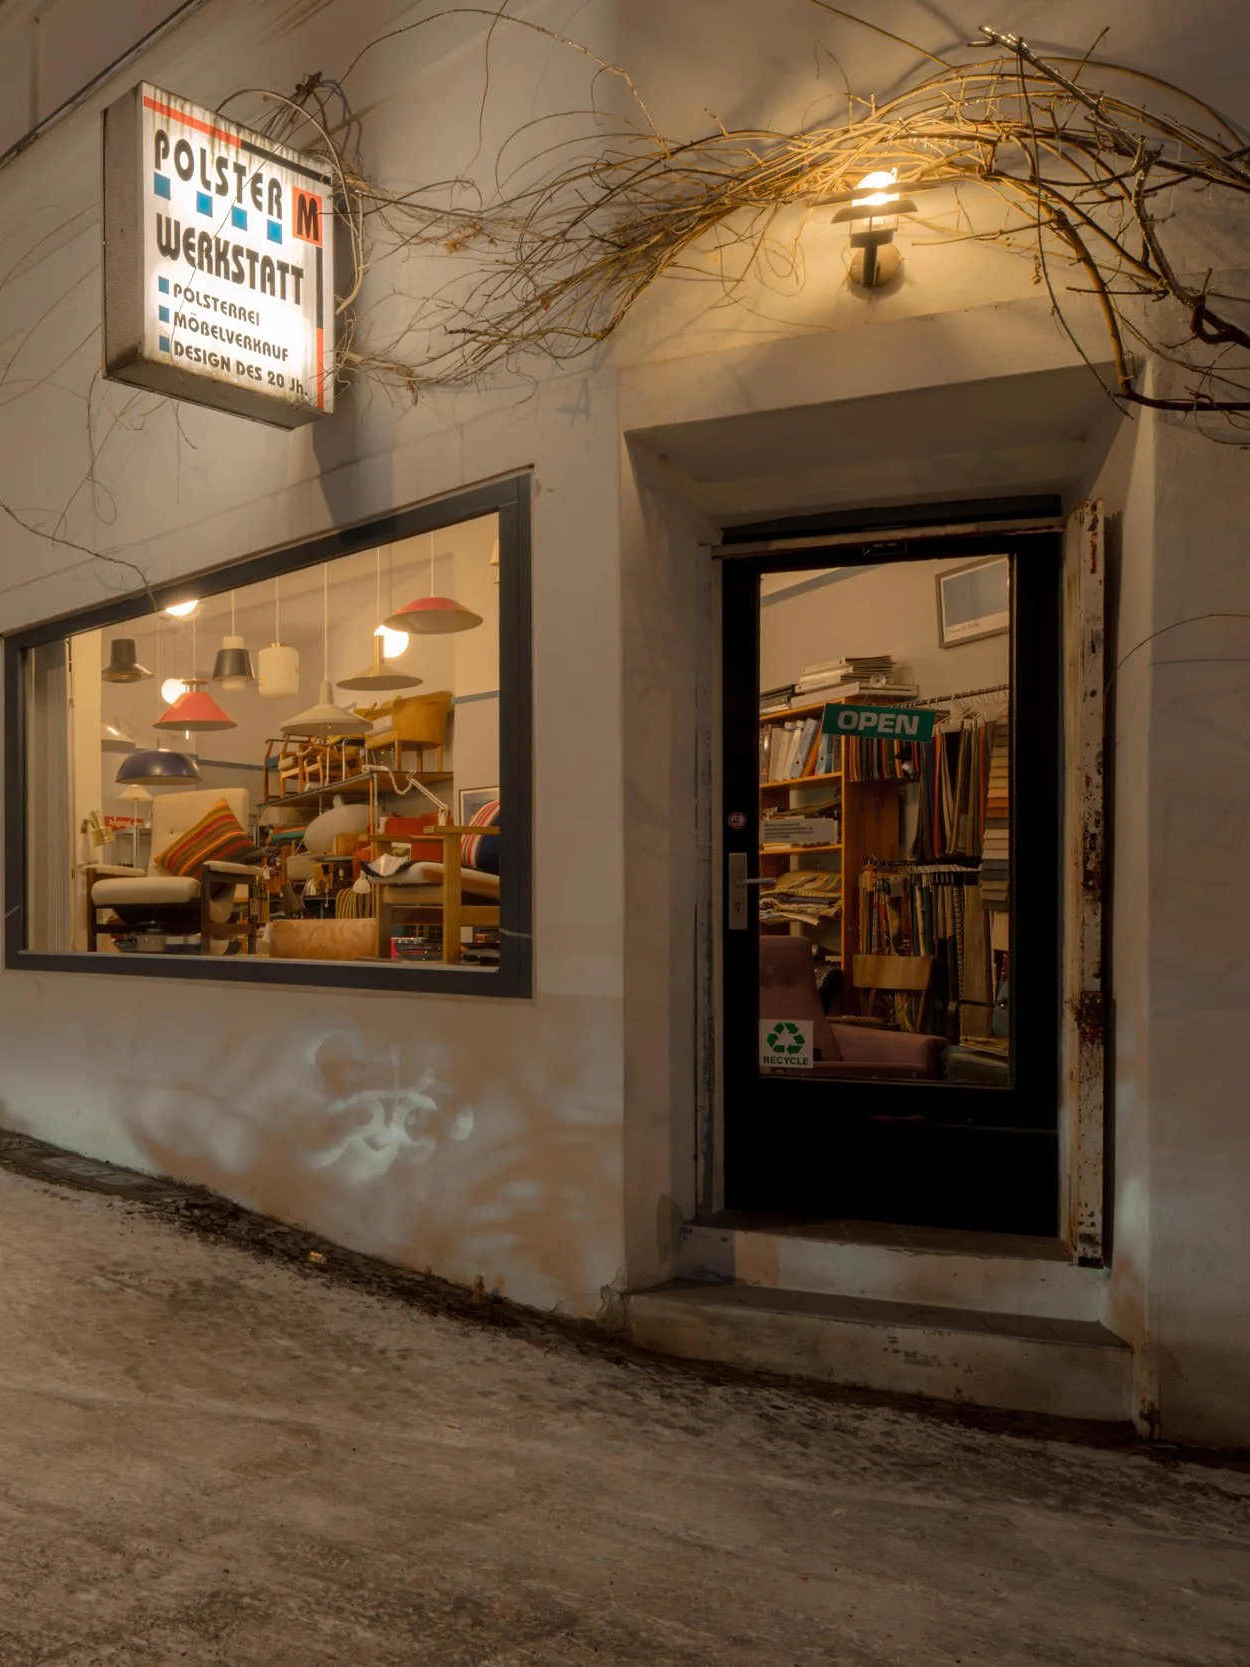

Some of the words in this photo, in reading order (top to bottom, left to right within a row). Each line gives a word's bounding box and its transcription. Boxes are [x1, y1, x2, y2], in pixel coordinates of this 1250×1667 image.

[155, 129, 283, 219] POLSTER
[297, 193, 319, 241] M
[156, 213, 304, 305] WERKSTATT
[173, 283, 260, 326] POLSTERREI
[173, 311, 289, 362] MÖBELVERKAUF
[174, 340, 231, 372] DESIGN
[236, 360, 263, 381] DES
[267, 370, 285, 388] 20
[289, 379, 308, 396] Jh.
[837, 709, 920, 736] OPEN
[763, 1056, 809, 1065] RECYCLE
